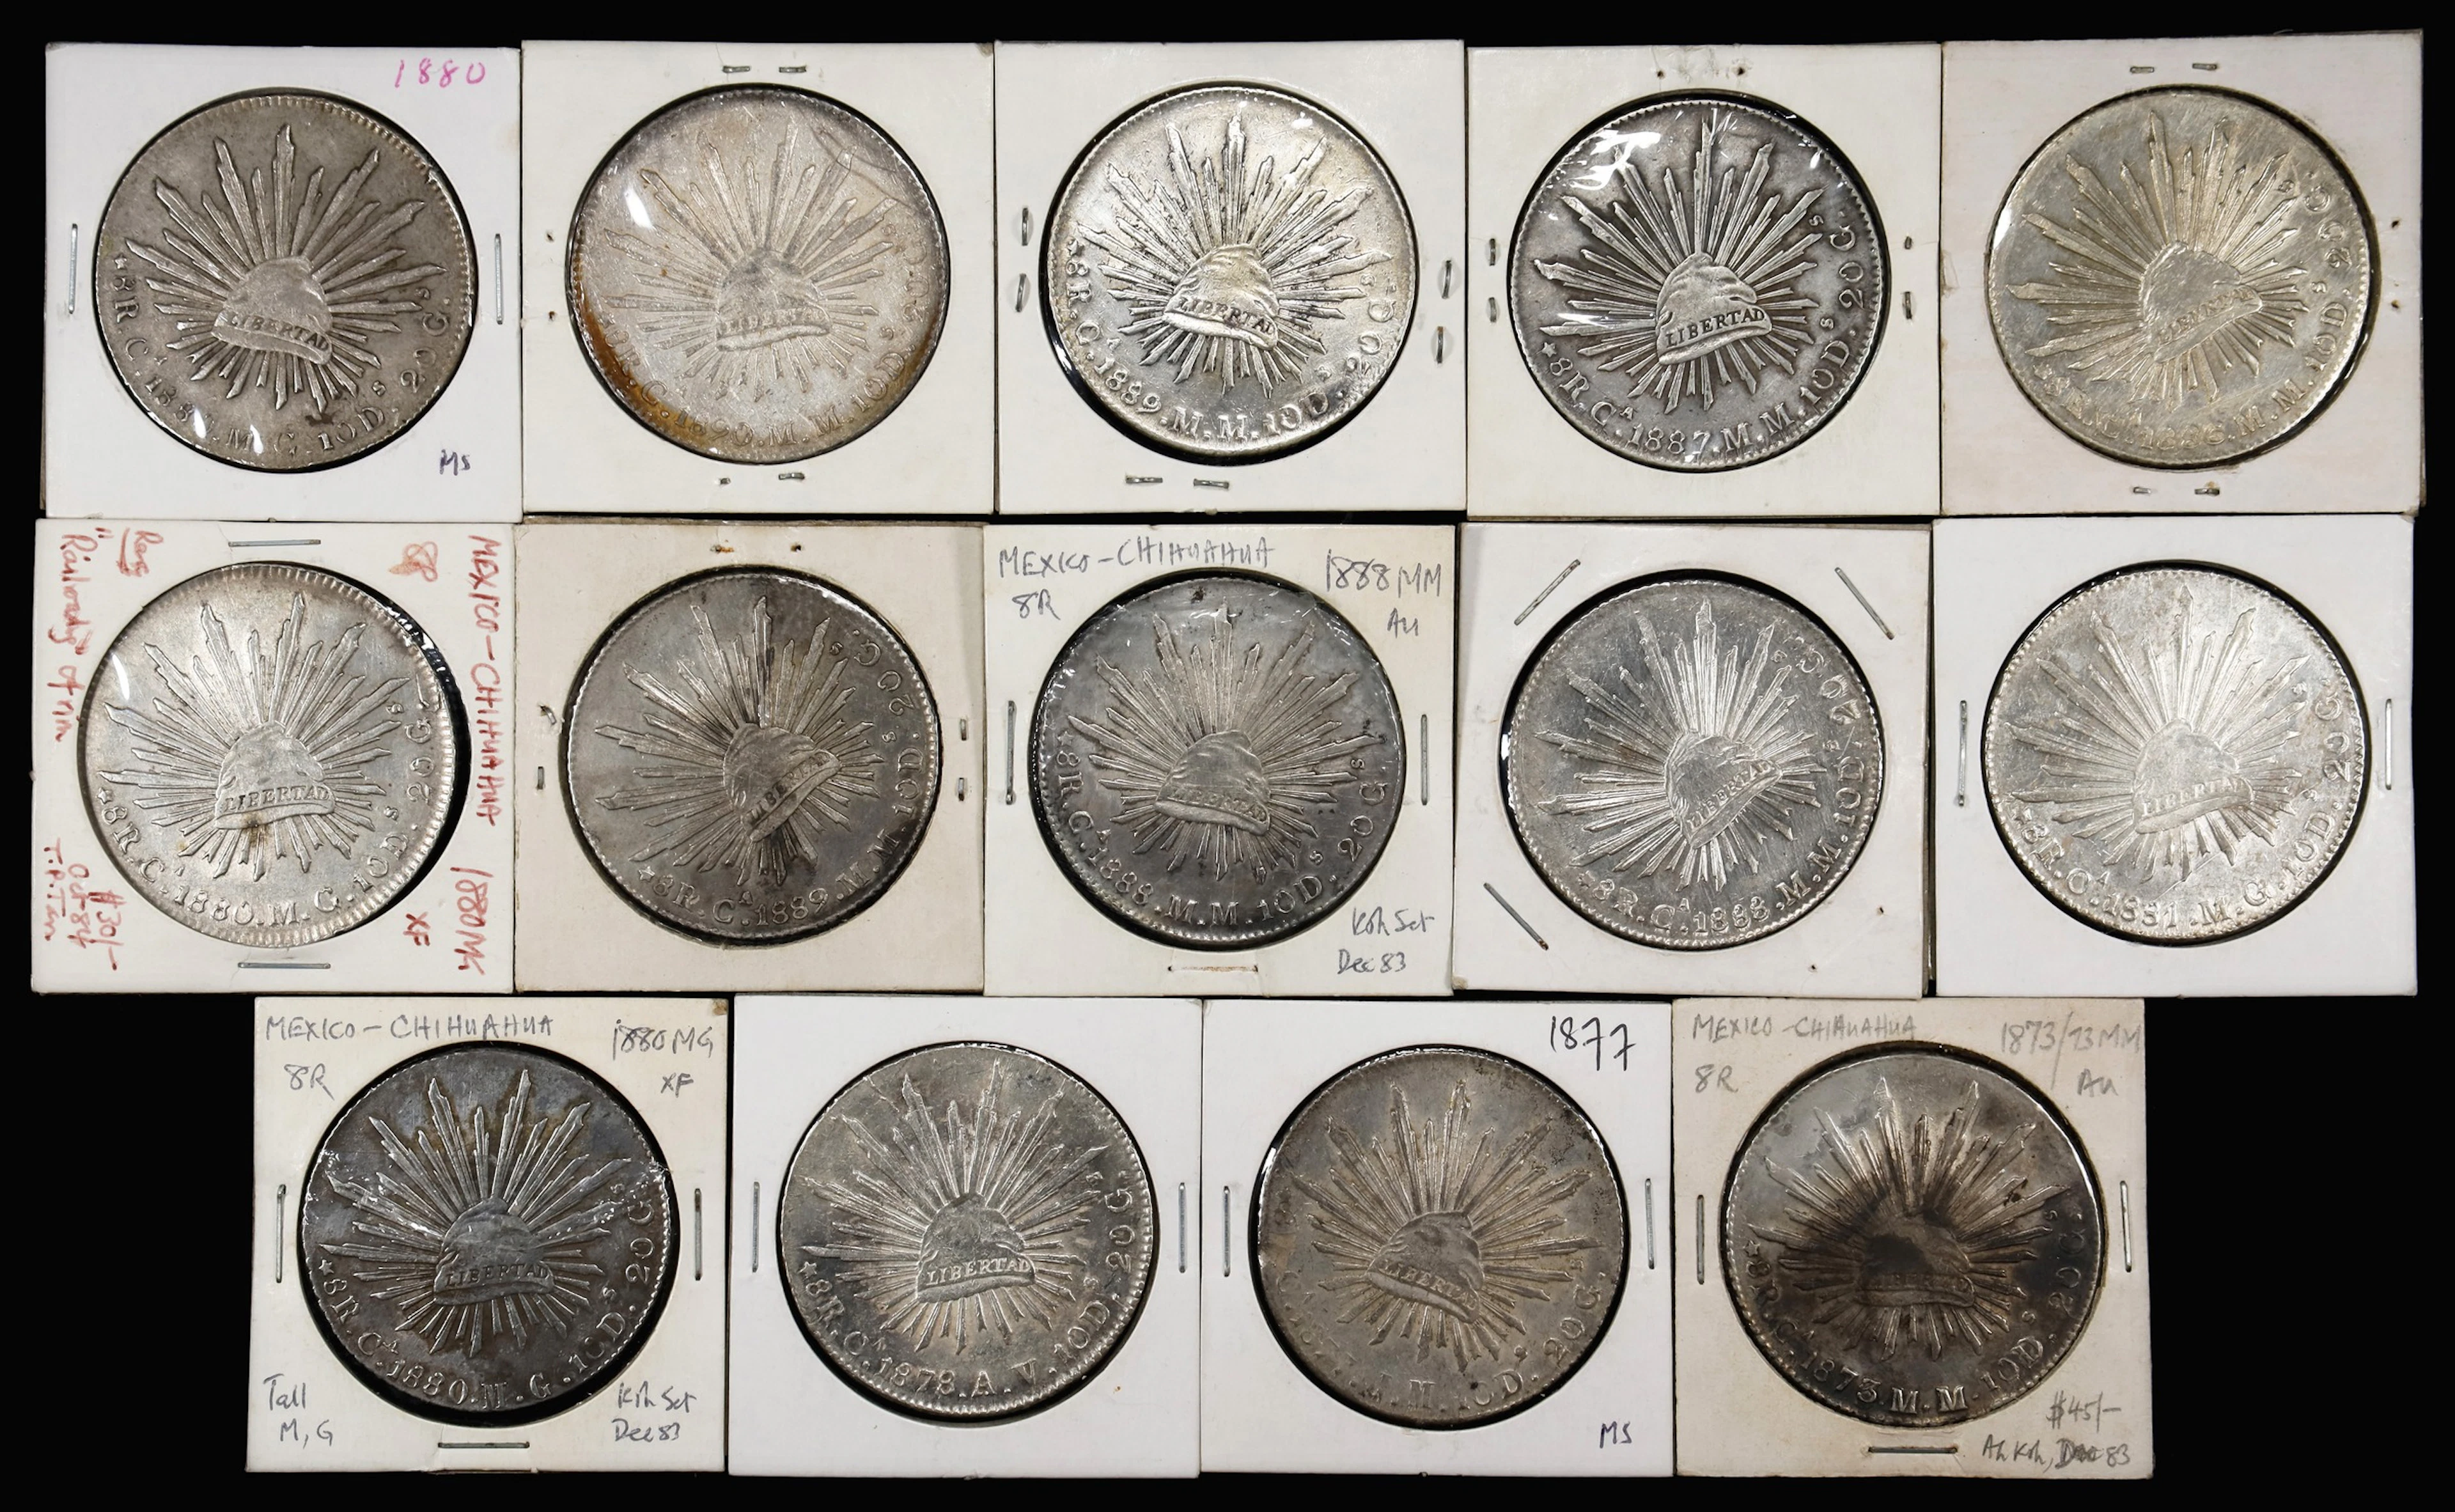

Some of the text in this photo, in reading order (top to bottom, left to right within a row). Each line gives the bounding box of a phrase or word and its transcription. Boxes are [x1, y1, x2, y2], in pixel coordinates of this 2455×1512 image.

[394, 58, 486, 88] 1880
[230, 315, 331, 352] LIBERTAD
[1665, 308, 1766, 347] LIBERTAD
[440, 449, 470, 476] MS
[1012, 591, 1061, 621] 8R
[224, 787, 331, 813] LIBERTAD
[1687, 761, 1773, 830] LIBERTAD
[403, 912, 431, 947] XF
[1548, 1015, 1637, 1072] 1877
[284, 1064, 335, 1101] 8R
[660, 1073, 694, 1097] XF
[1695, 1066, 1740, 1094] 8R
[445, 1262, 550, 1287] LIBERTAD
[926, 1257, 1032, 1286] LIBERTAD
[263, 1373, 307, 1410] Tall
[1599, 1421, 1633, 1449] MS
[2107, 1444, 2131, 1467] 83
